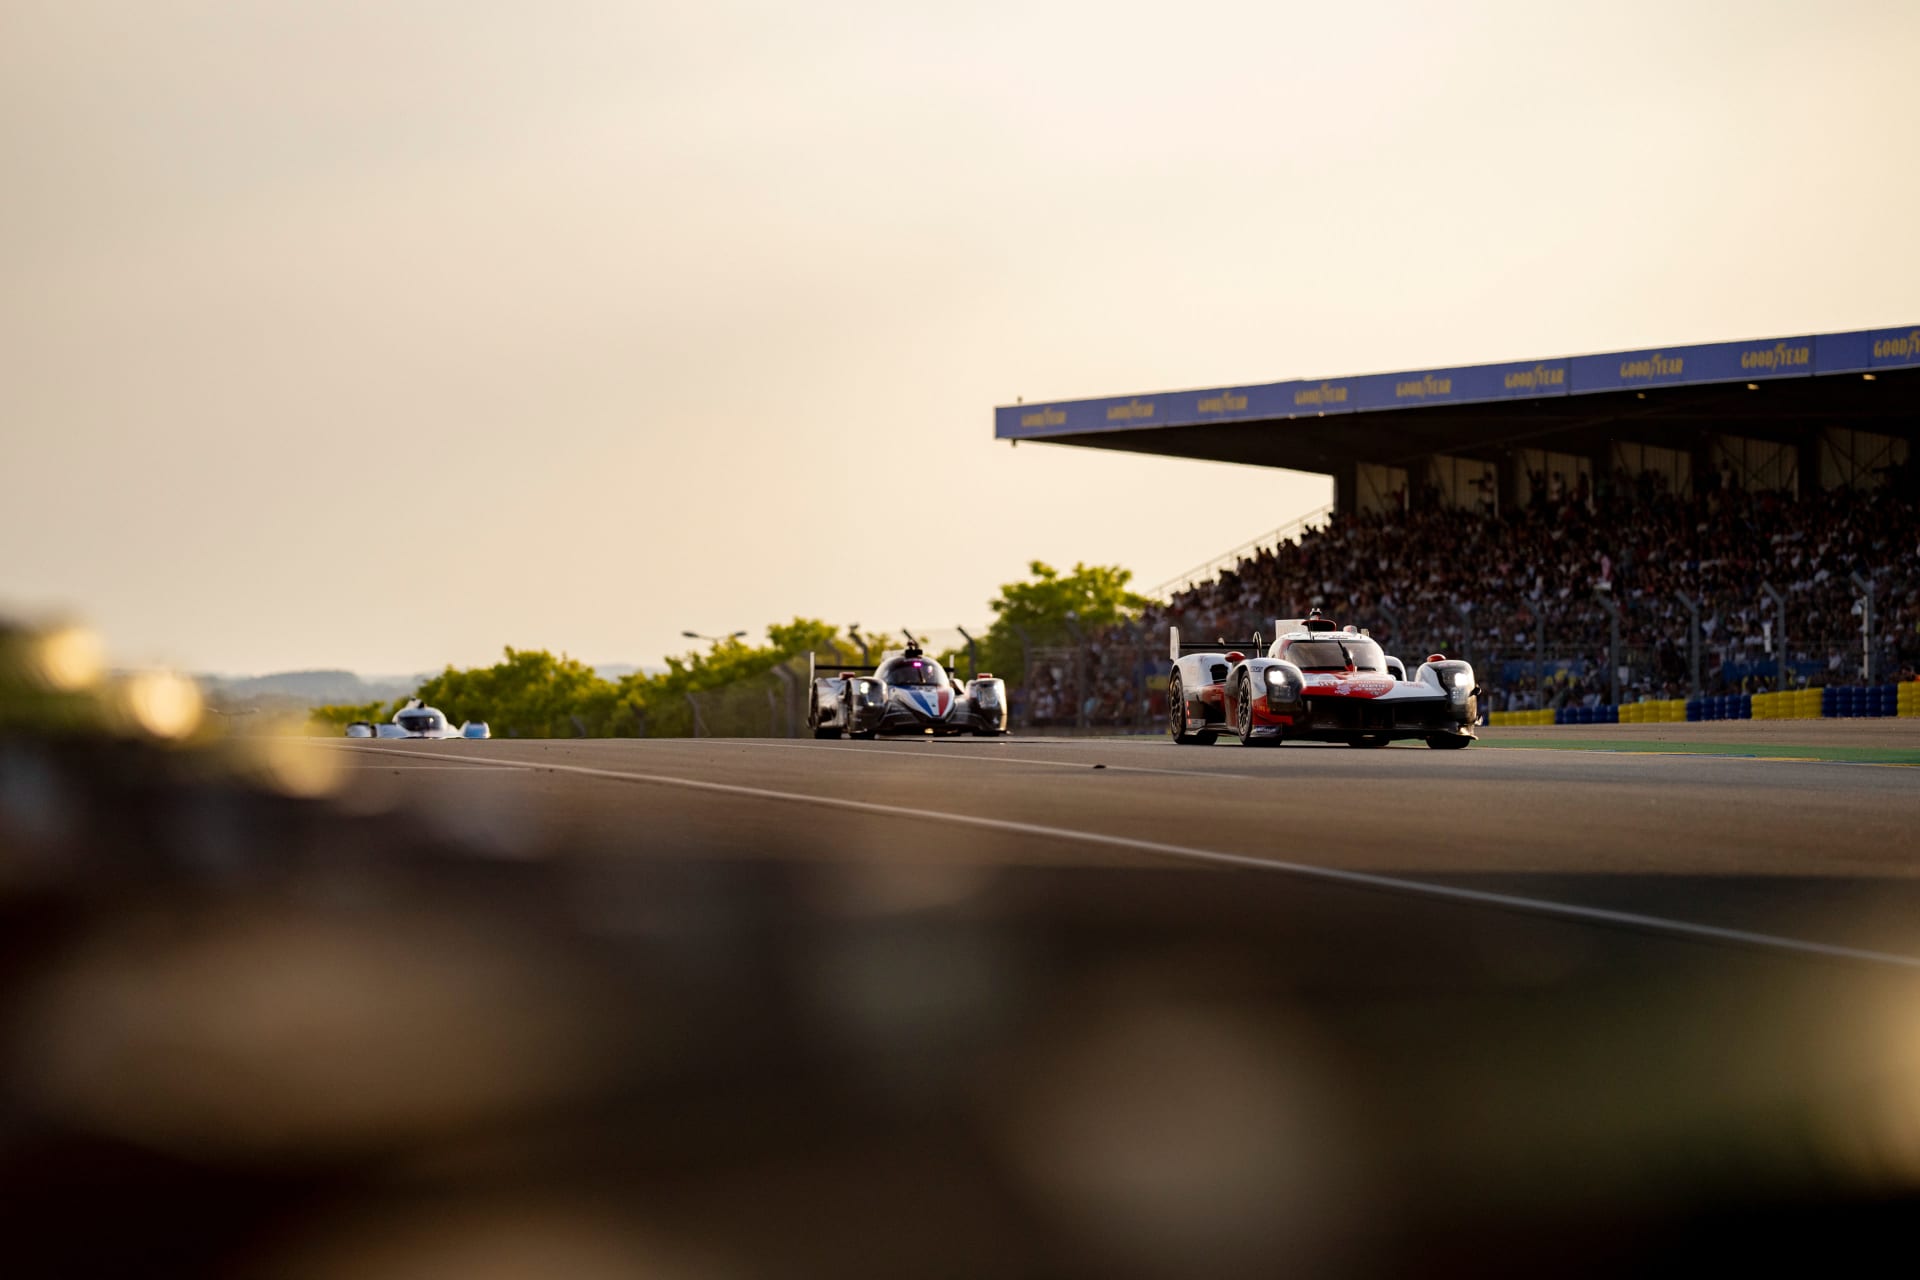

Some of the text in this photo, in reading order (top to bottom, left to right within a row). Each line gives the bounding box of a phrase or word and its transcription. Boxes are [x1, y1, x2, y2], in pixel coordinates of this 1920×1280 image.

[1620, 354, 1683, 379] GOODYEAR
[1741, 343, 1808, 369] GOODYEAR
[1504, 364, 1564, 388] GOODYEAR
